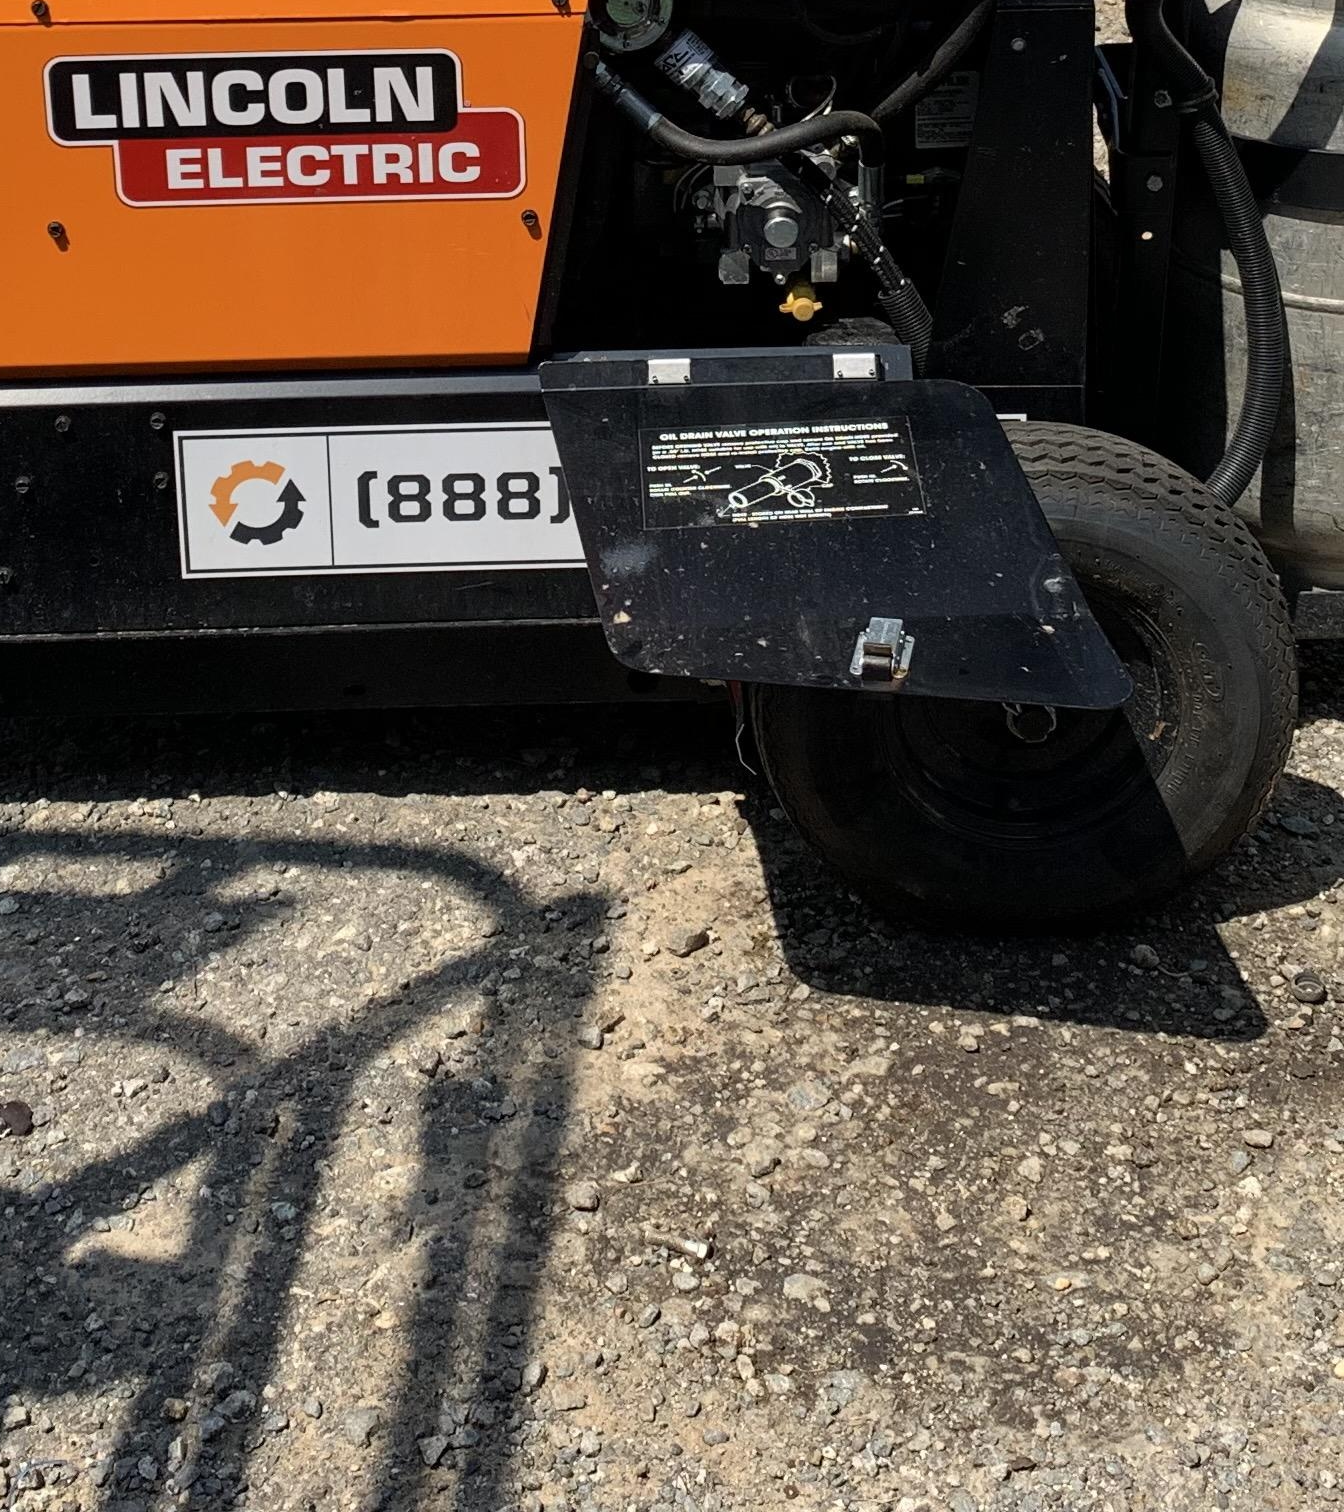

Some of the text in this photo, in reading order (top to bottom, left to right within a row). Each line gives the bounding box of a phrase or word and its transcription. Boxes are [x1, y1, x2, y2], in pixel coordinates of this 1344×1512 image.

[71, 66, 435, 130] LINCOLN
[165, 142, 481, 190] ELECTRIC
[659, 422, 889, 441] OIL DRAIN VALVE OPERATION INSTRUCTIONS
[357, 466, 572, 529] (888)
